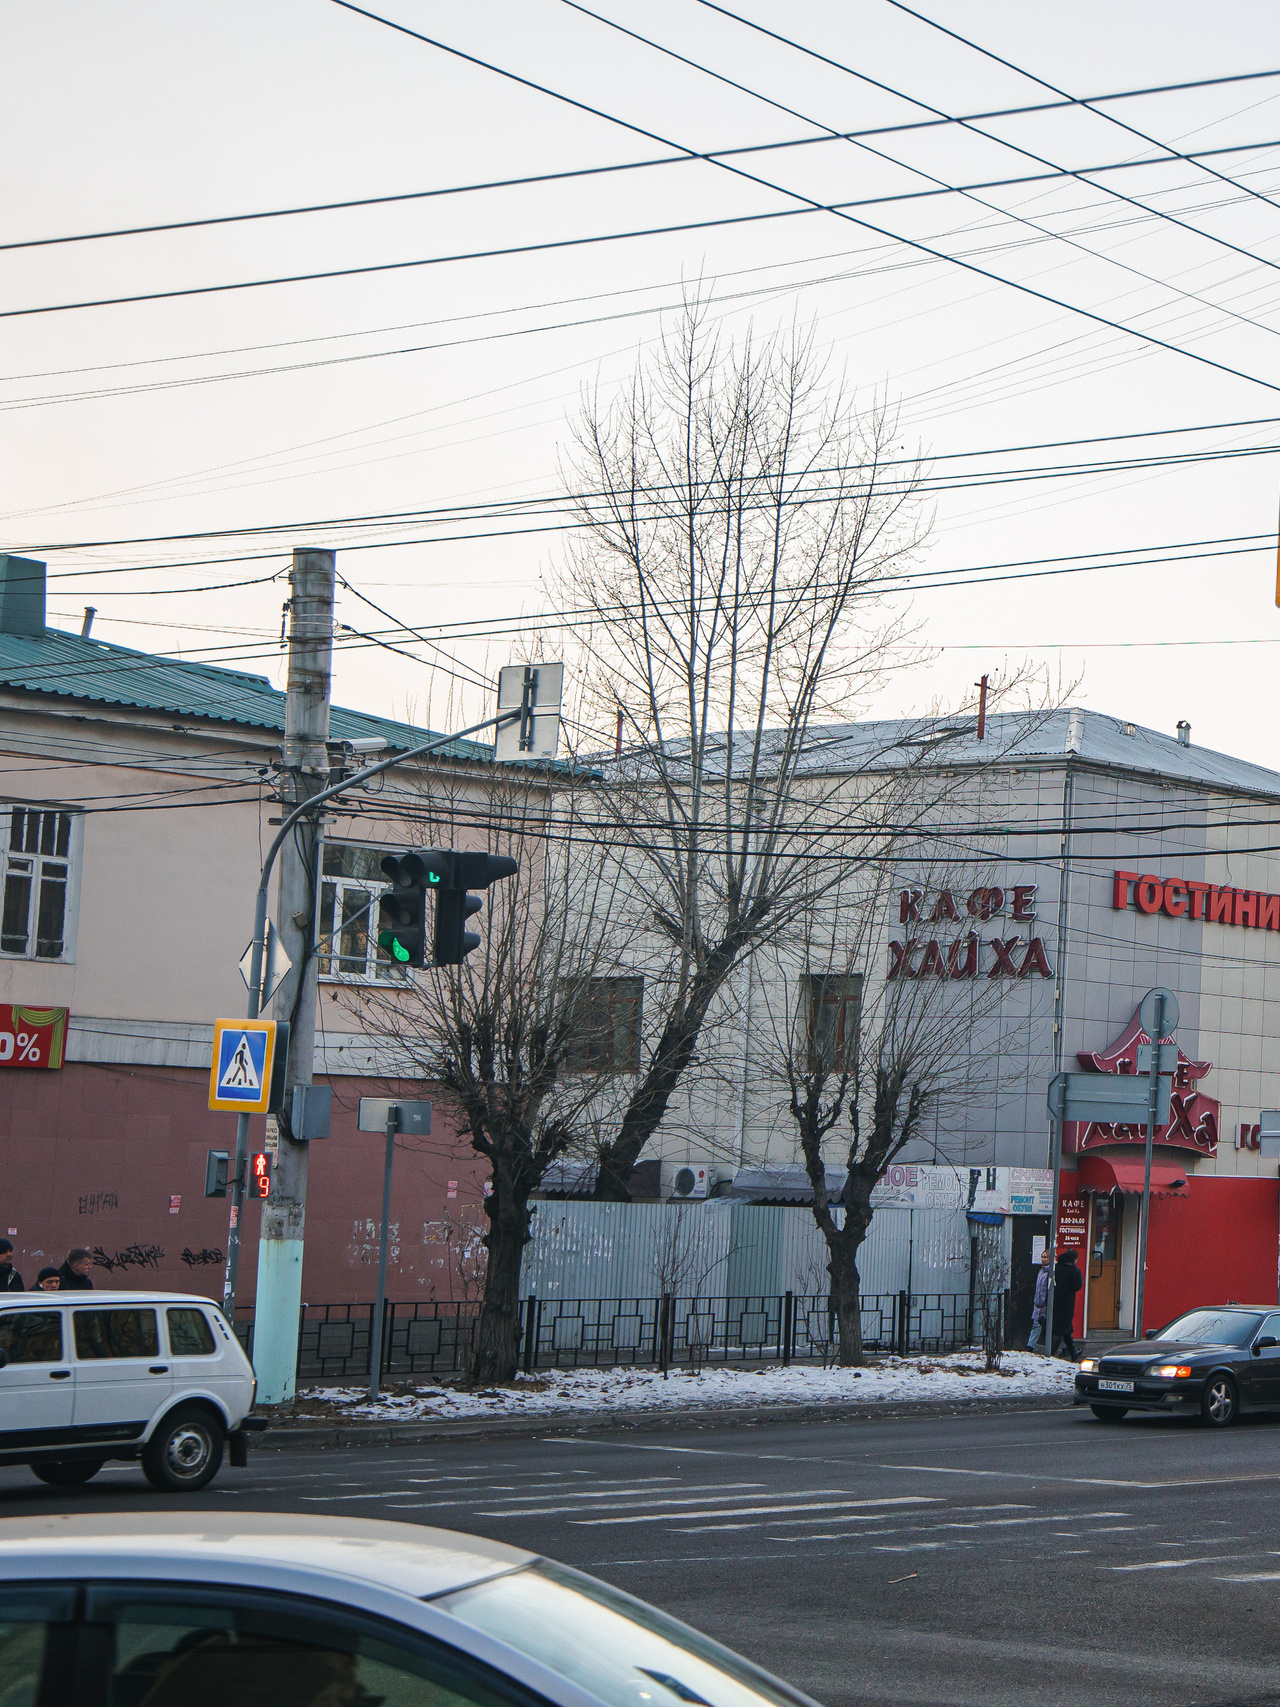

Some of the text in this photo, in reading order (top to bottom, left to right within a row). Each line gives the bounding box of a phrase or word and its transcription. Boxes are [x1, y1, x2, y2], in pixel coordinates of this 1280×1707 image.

[900, 884, 1038, 926] КАФЕ
[886, 929, 1054, 981] ХАЙ ХА
[259, 1176, 270, 1197] 9
[921, 1173, 969, 1191] РЕМОНТ
